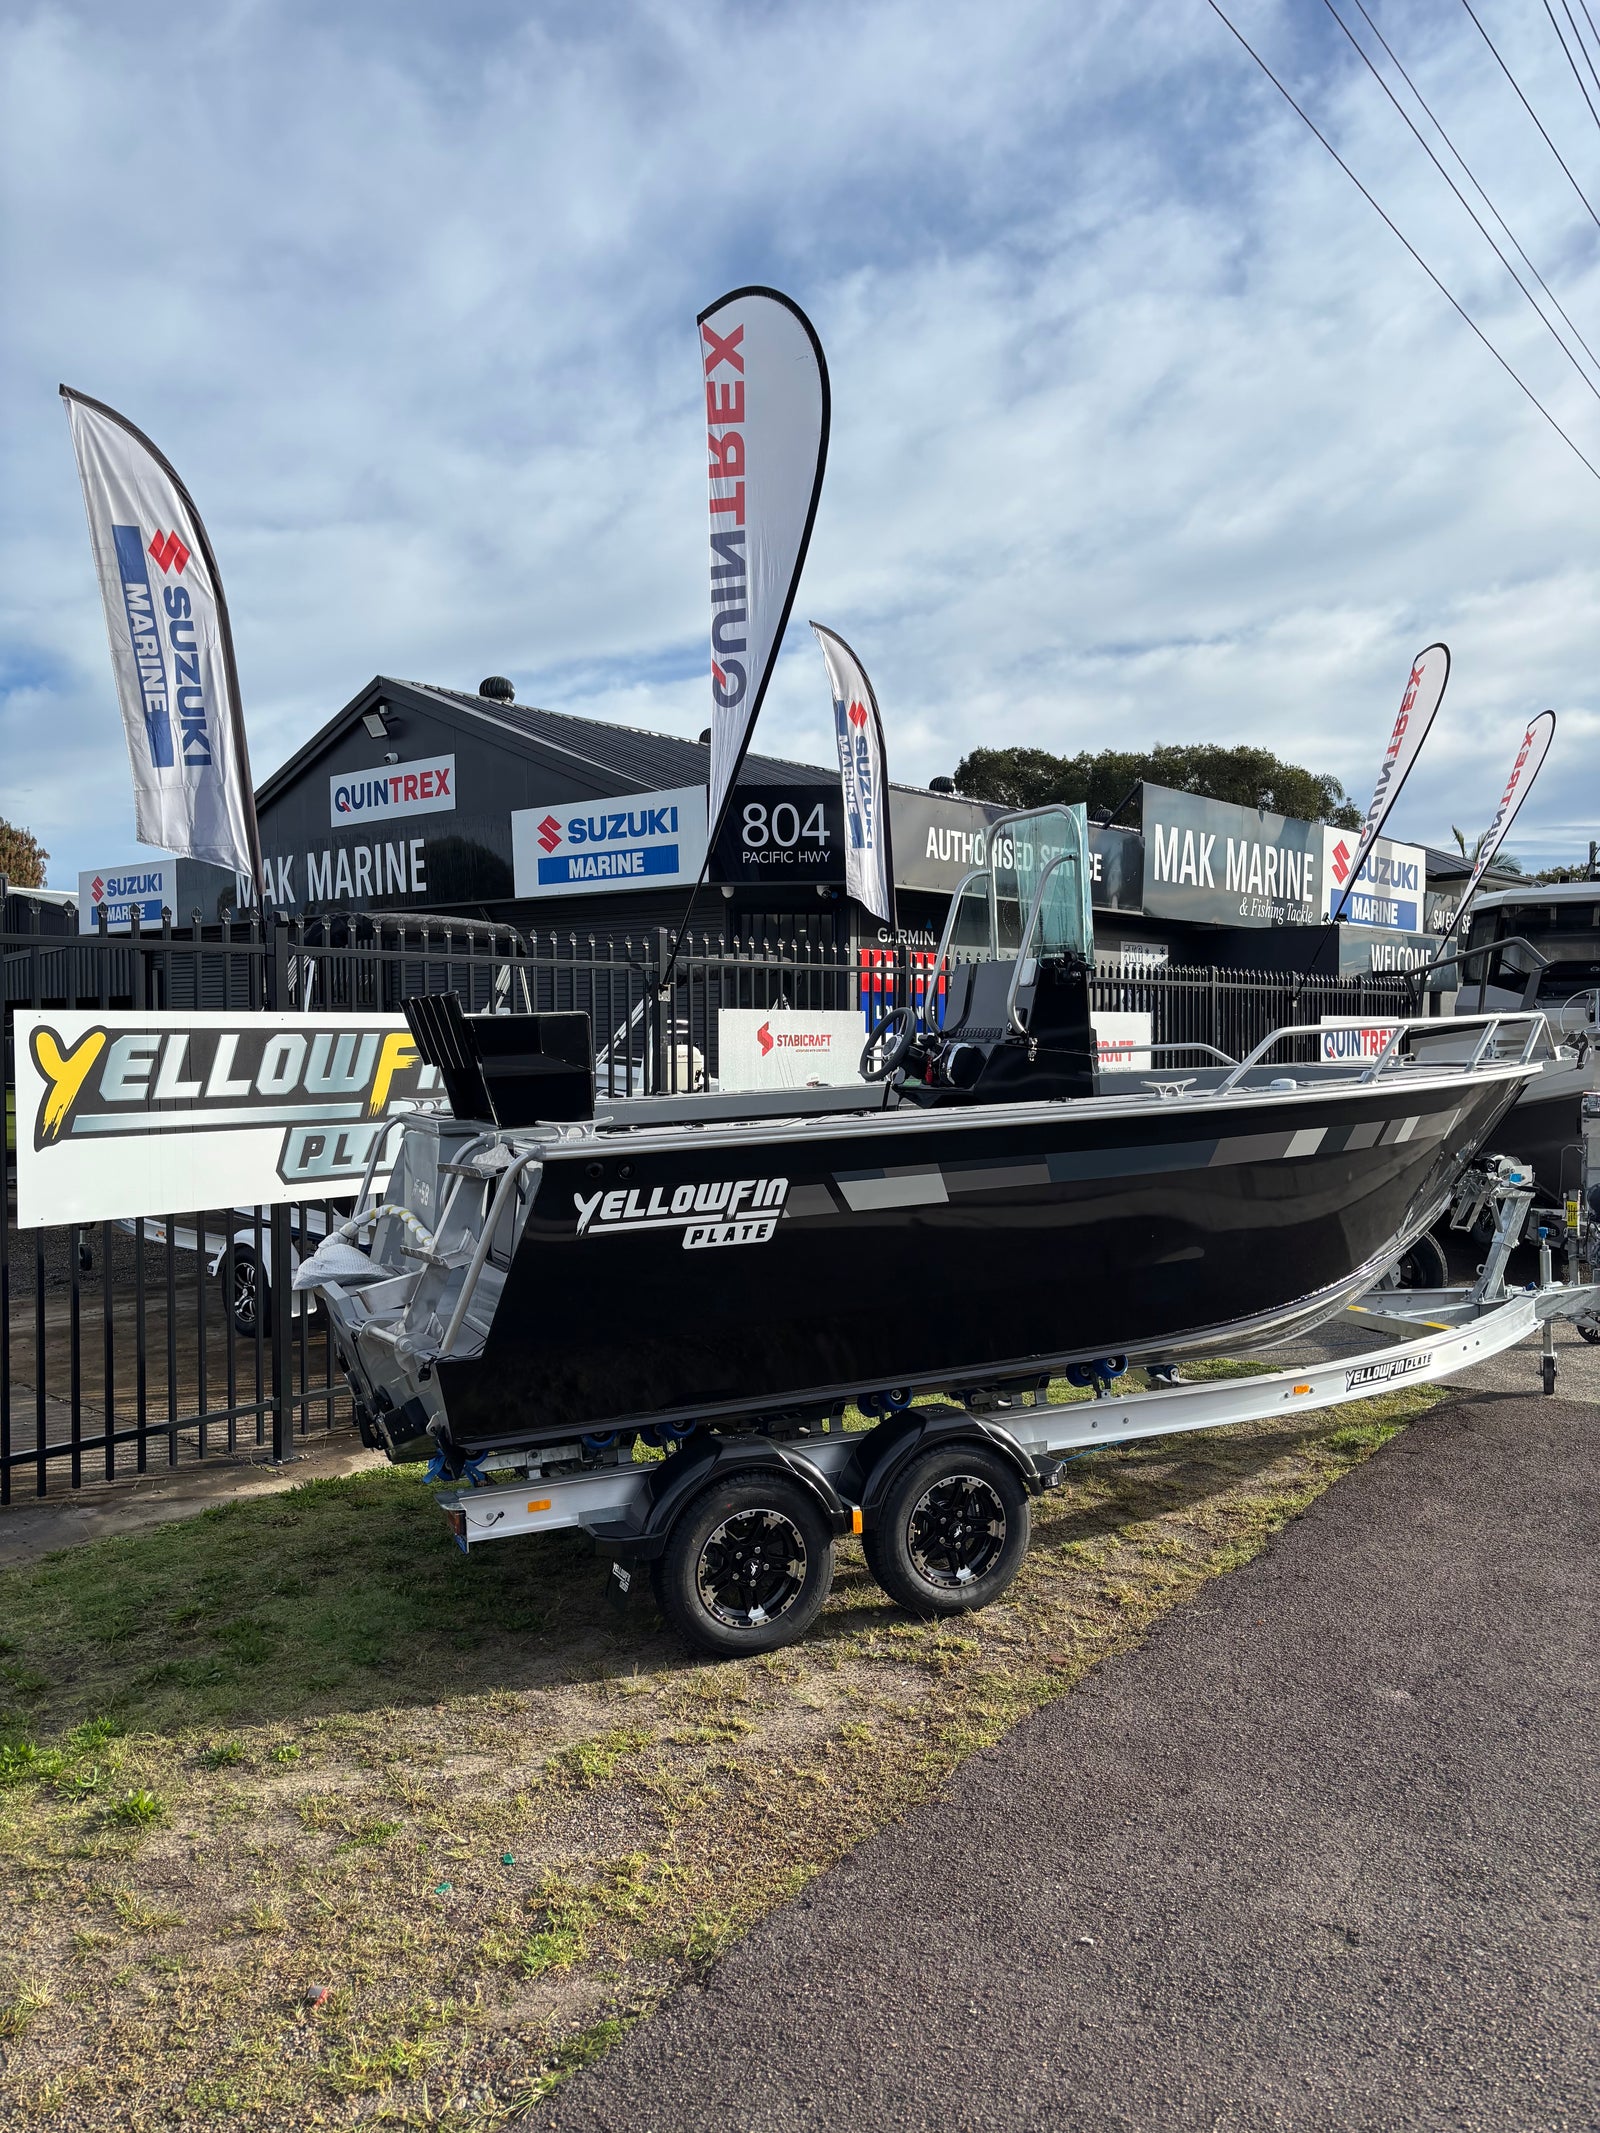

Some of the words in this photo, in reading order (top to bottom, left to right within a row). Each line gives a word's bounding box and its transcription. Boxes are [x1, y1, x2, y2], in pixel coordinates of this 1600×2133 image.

[125, 582, 168, 714] MARINE
[163, 586, 212, 766] SUZUKI
[334, 767, 450, 813] QUINTREX
[839, 735, 859, 814] MARINE
[855, 735, 873, 849] SUZUKI
[568, 806, 678, 844] SUZUKI
[742, 802, 831, 847] 804
[235, 855, 296, 909] MAK
[307, 838, 427, 901] MARINE
[568, 851, 645, 879] MARINE
[742, 851, 794, 864] PACIFIC
[799, 850, 831, 863] HWY
[1040, 843, 1102, 882] SERCE
[1154, 823, 1216, 889] MAK
[1225, 837, 1314, 903] MARINE
[107, 872, 162, 897] SUZUKI
[108, 903, 146, 921] MARIE
[1239, 896, 1248, 916] &
[1250, 898, 1285, 924] Fishing
[1286, 902, 1314, 923] Tackle
[1351, 896, 1399, 925] MARINE
[1371, 944, 1432, 981] WELCOME
[776, 1034, 832, 1047] STABICRAFT
[1097, 1040, 1134, 1063] RAFT
[35, 1031, 446, 1141] YELLOWF
[292, 1129, 404, 1172] PLA
[573, 1177, 789, 1236] YELLOWFIN
[688, 1222, 770, 1246] PLATE
[1346, 1360, 1405, 1392] YELLOWFIN
[1406, 1352, 1432, 1370] PLATE
